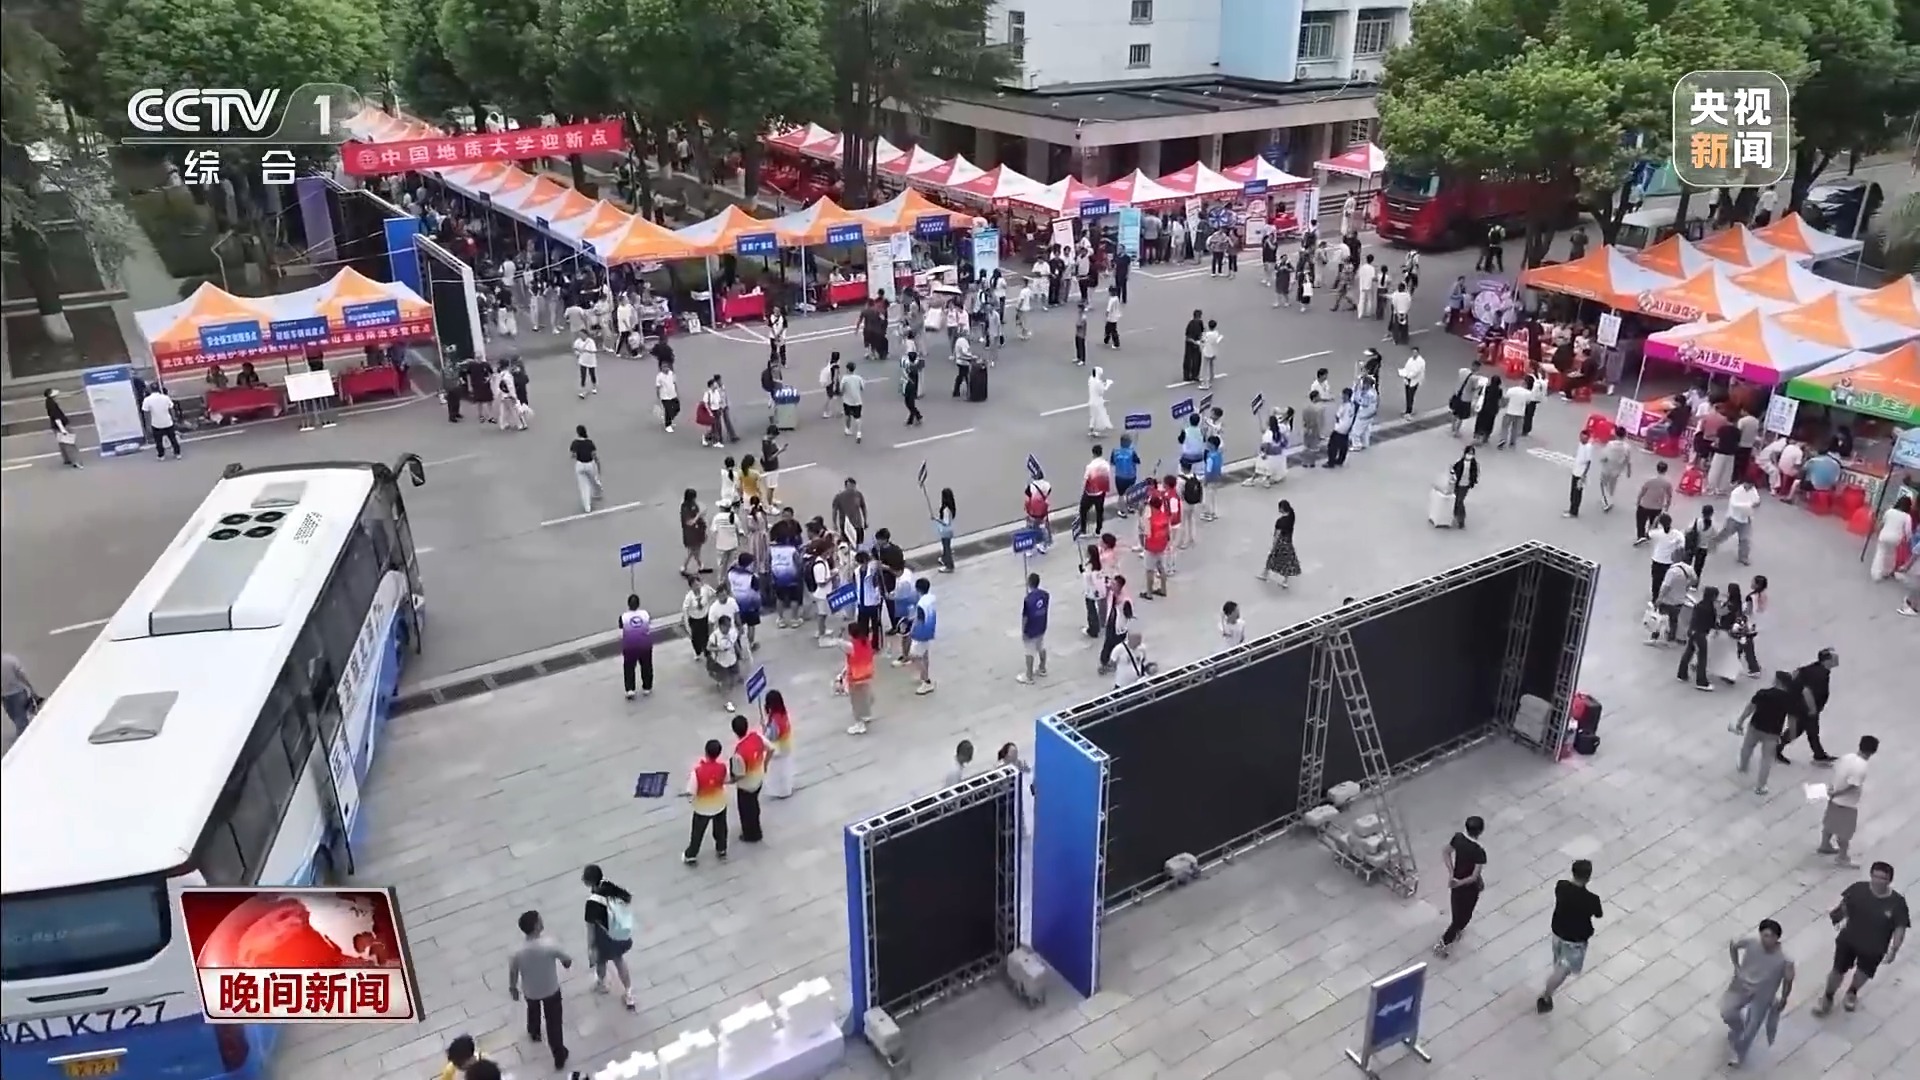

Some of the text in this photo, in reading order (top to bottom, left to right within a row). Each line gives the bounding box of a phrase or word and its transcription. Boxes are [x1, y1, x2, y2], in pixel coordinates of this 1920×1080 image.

[381, 129, 607, 167] 中国地质大学迎新点
